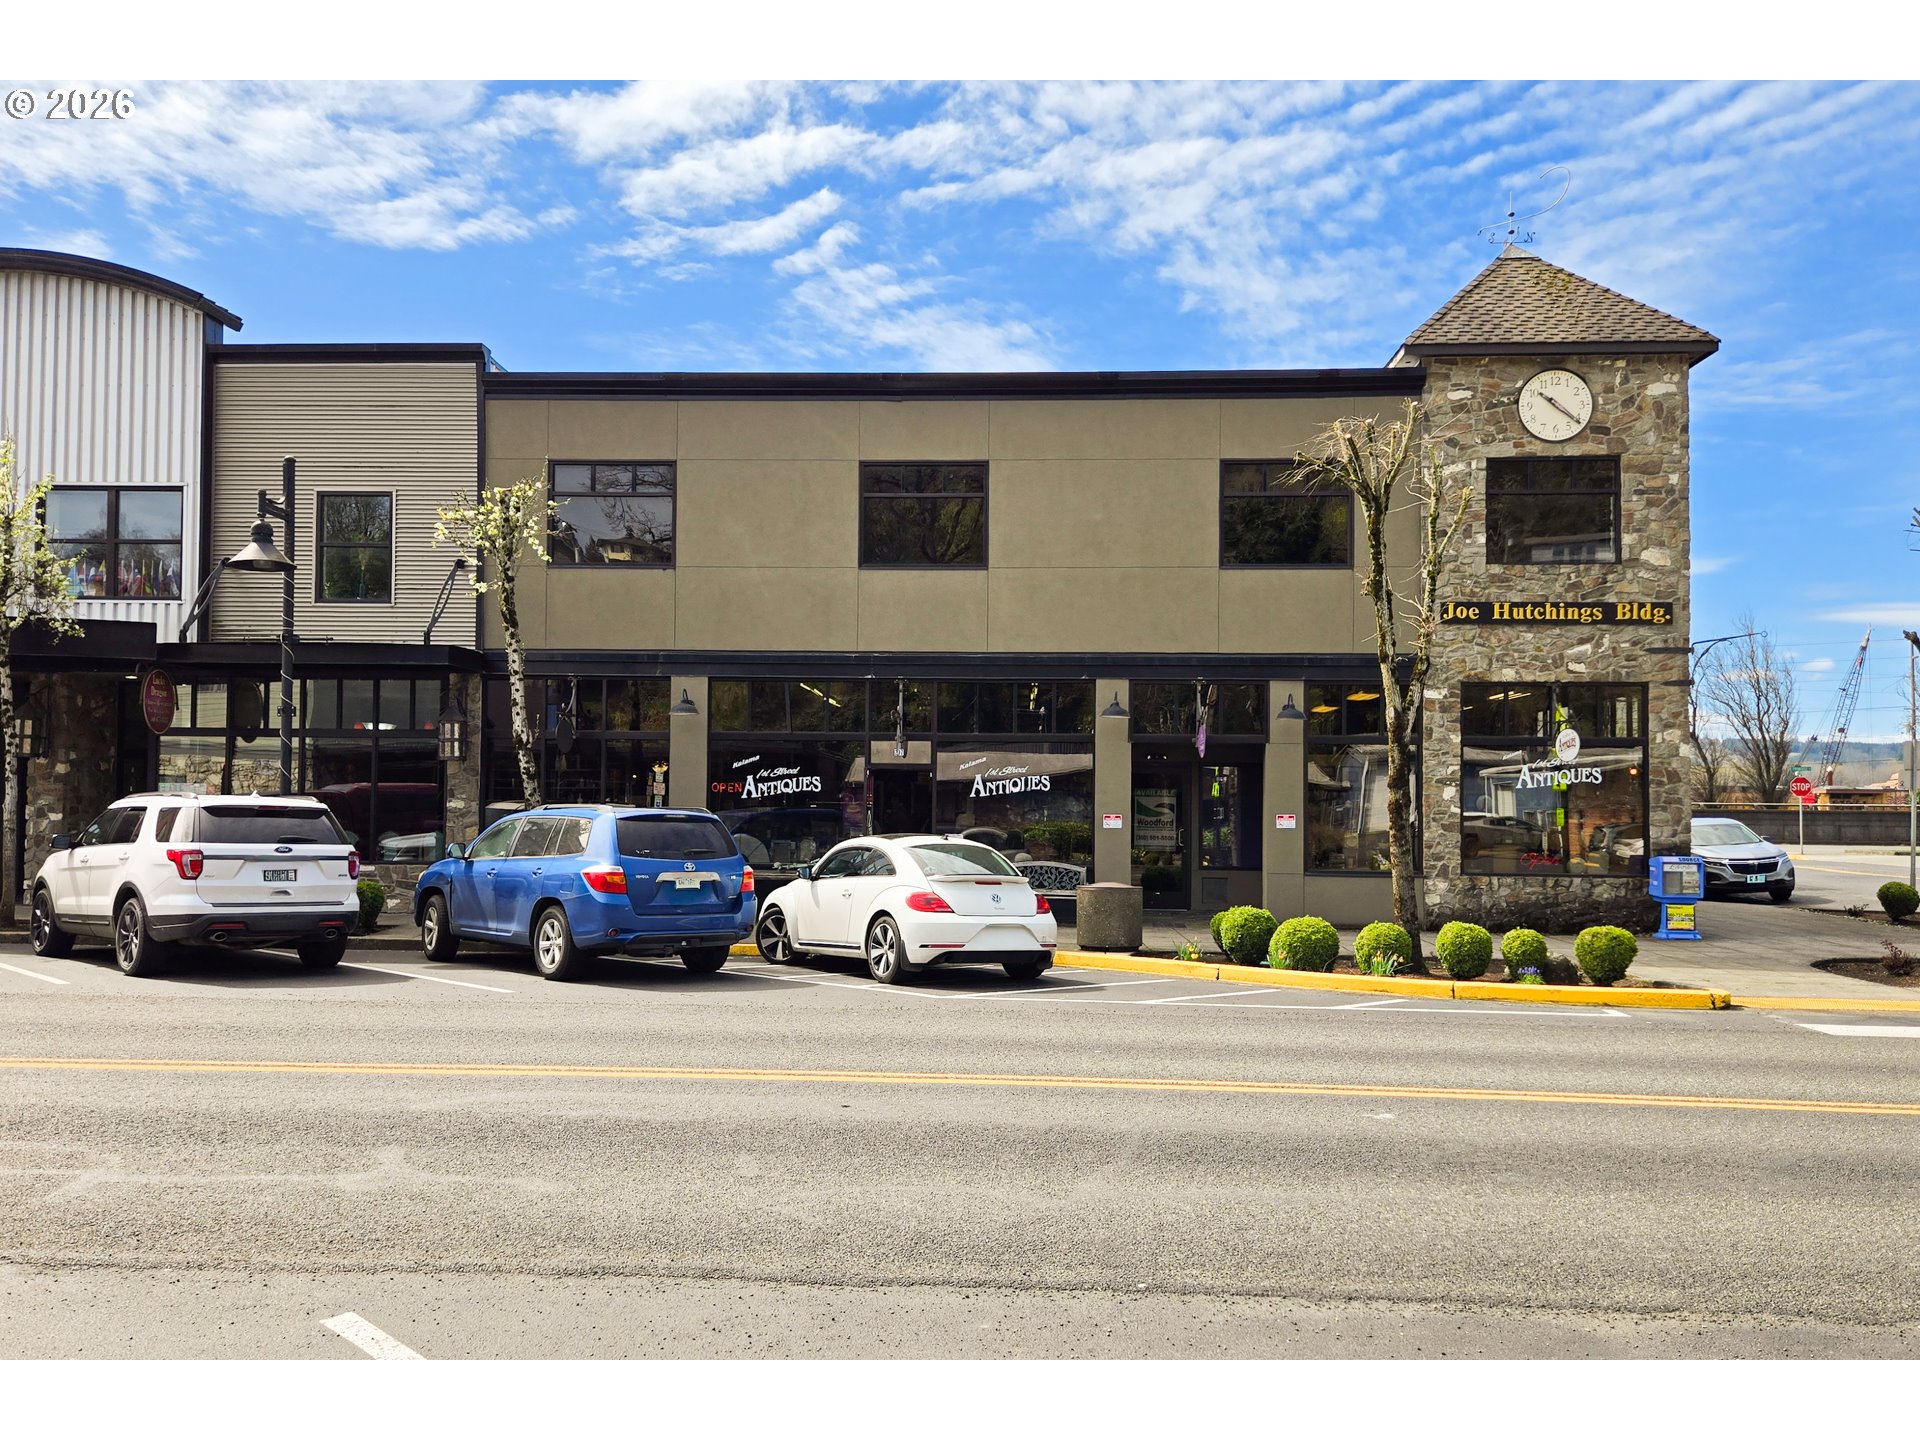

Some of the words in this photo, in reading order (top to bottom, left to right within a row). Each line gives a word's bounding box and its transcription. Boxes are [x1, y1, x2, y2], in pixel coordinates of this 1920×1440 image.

[1539, 380, 1548, 389] 11
[1550, 376, 1562, 386] 12
[1565, 378, 1570, 388] 1
[1529, 388, 1540, 398] 10
[1573, 387, 1580, 396] 2
[1526, 401, 1533, 411] 9
[1579, 400, 1586, 410] 3
[1530, 414, 1537, 424] 8
[1540, 423, 1547, 432] 7
[1552, 423, 1559, 434] 6
[1565, 421, 1572, 431] 5
[1443, 602, 1480, 620] Joe
[1492, 602, 1603, 624] Hutchings
[1615, 602, 1671, 624] Bldg.
[732, 755, 760, 768] Kalama
[959, 757, 987, 770] Kalama
[770, 766, 800, 777] Street
[999, 765, 1029, 776] Street
[1516, 764, 1602, 789] ANTIQUES
[711, 782, 742, 793] OPEN
[741, 775, 821, 799] ANTIQUES
[1792, 783, 1811, 791] STOP
[1137, 819, 1174, 827] Woodford
